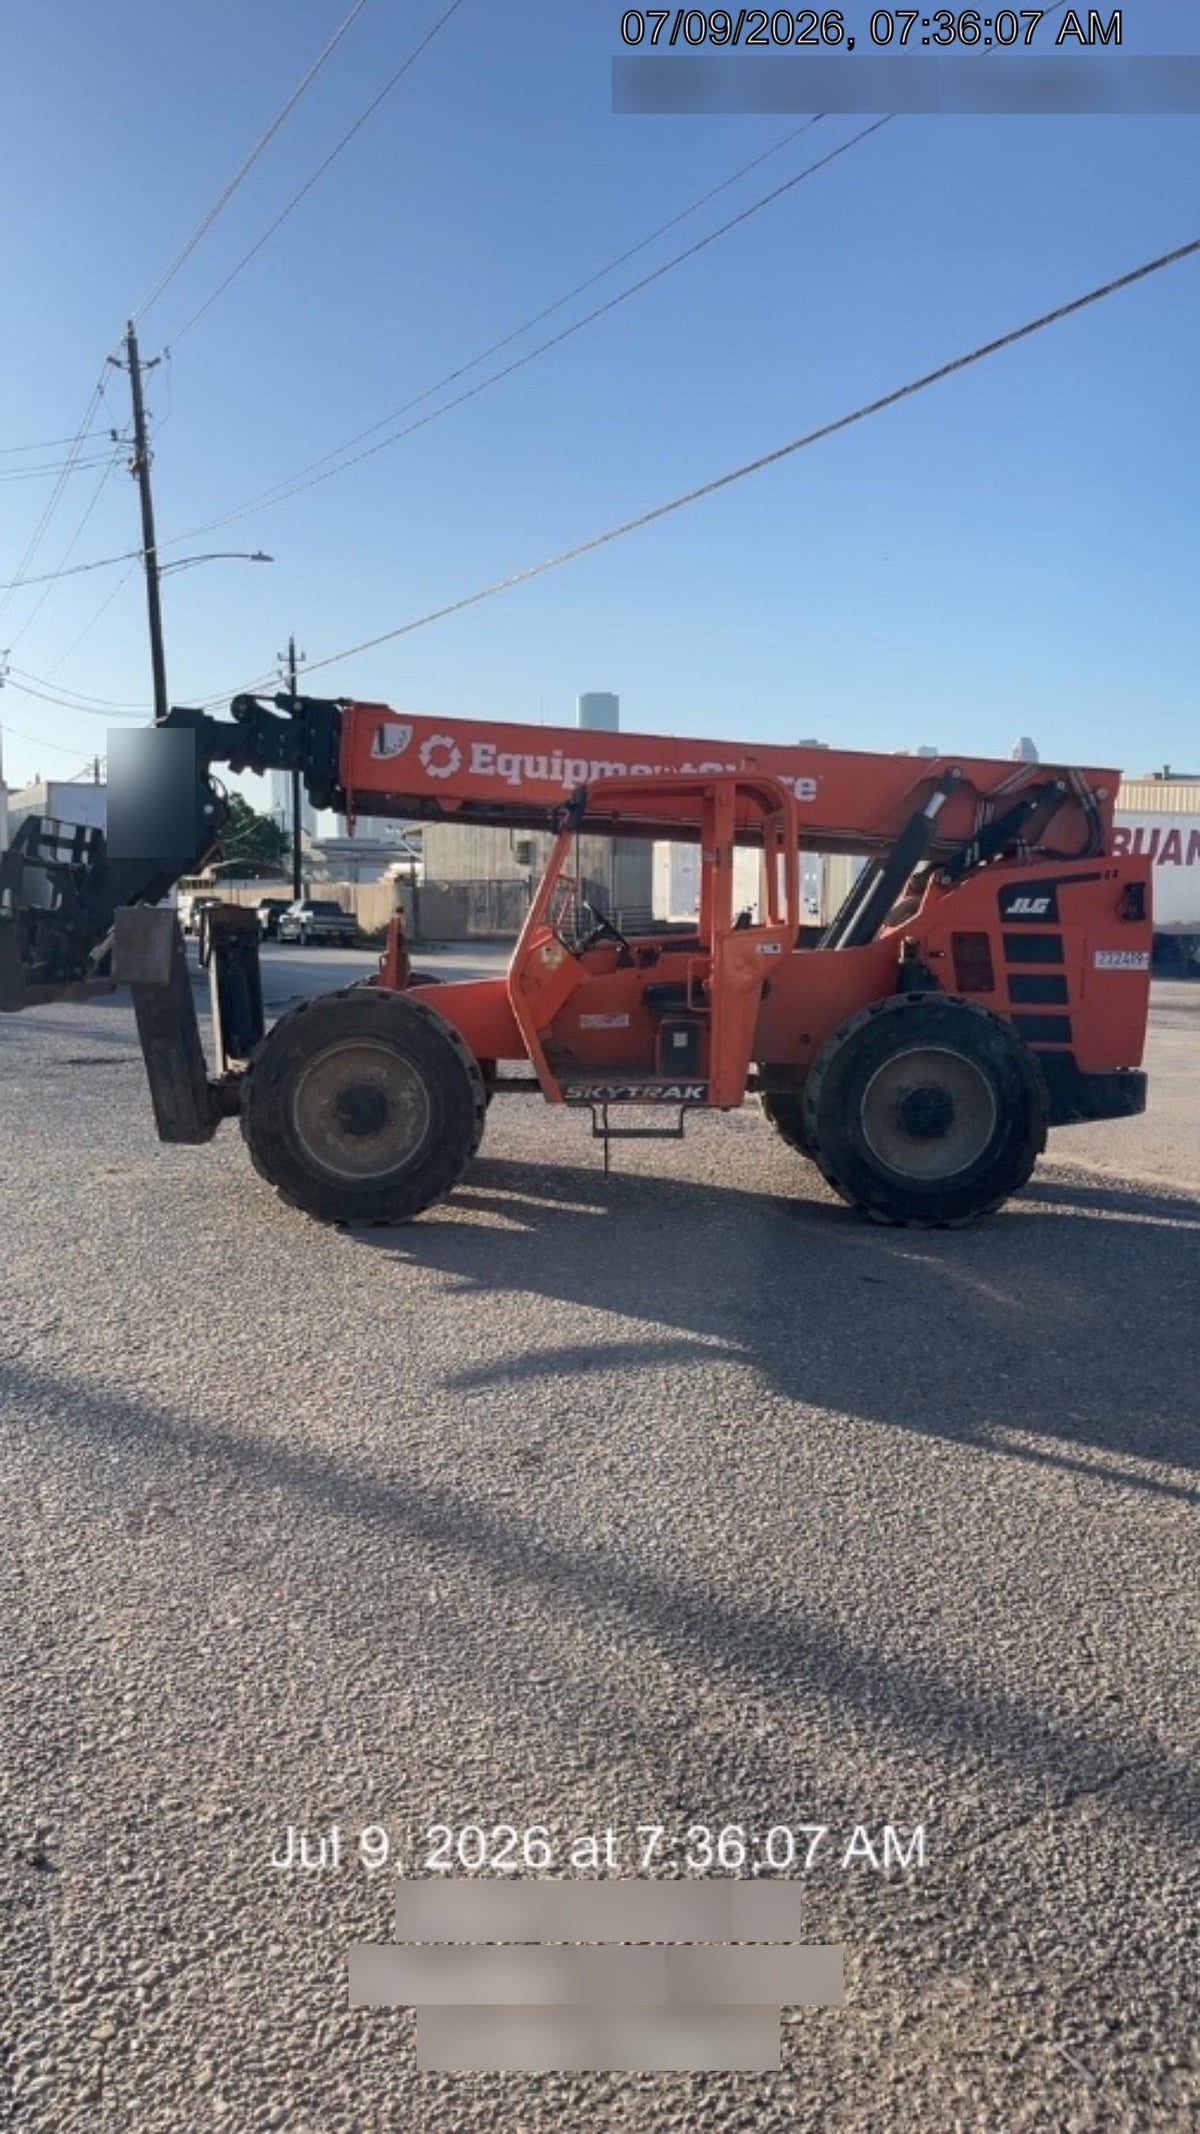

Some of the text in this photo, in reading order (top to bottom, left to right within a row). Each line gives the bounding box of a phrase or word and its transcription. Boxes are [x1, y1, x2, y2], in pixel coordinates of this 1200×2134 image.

[469, 742, 817, 802] Equipme
[1007, 898, 1051, 913] JLG
[564, 1085, 705, 1099] SKYTRAK
